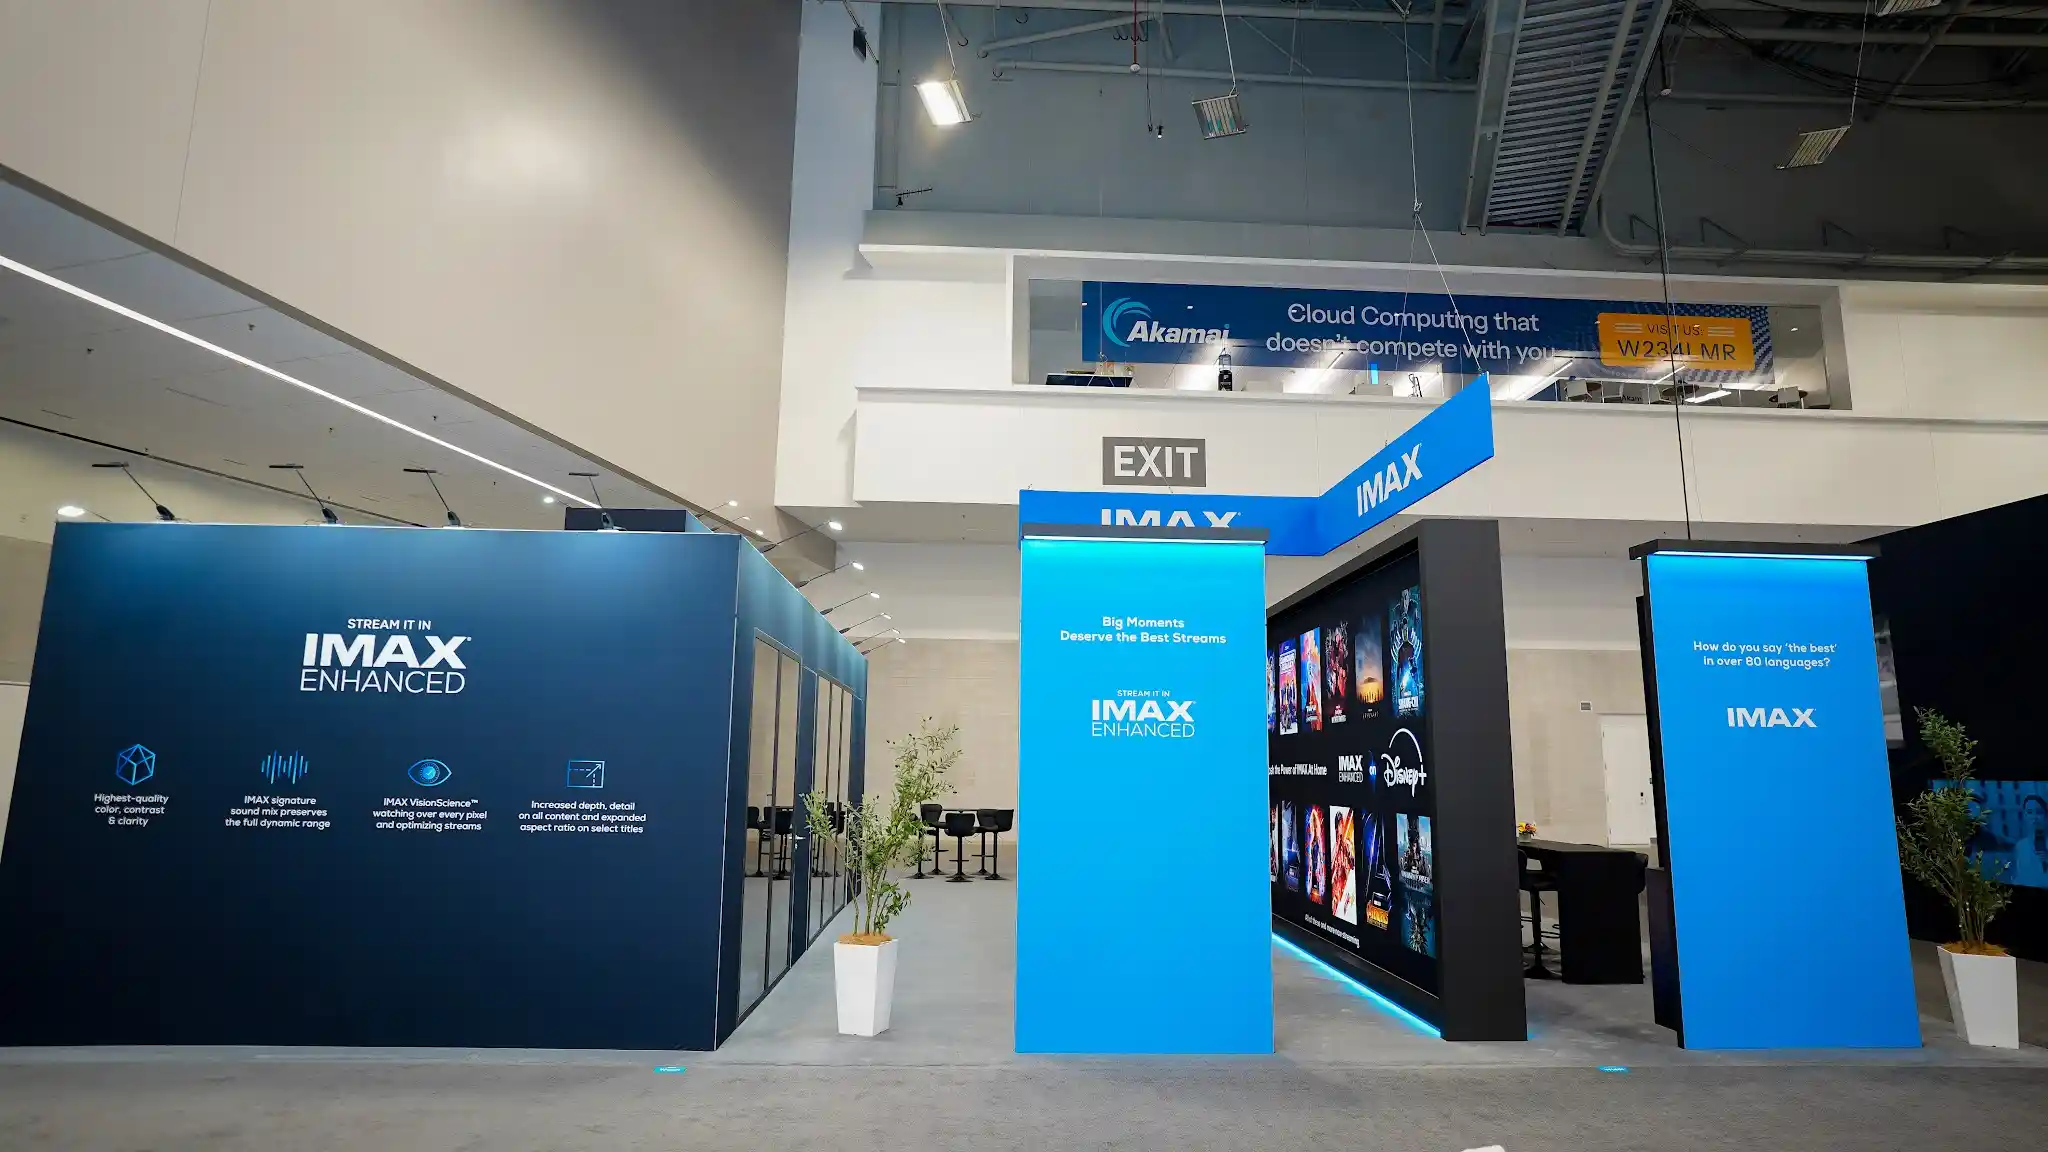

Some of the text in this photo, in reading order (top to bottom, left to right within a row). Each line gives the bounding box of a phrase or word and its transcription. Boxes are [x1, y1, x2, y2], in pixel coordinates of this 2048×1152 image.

[1288, 303, 1540, 335] Cloud Computing that
[1127, 320, 1230, 344] Akamai
[1647, 324, 1680, 337] VISIT
[1356, 339, 1458, 360] compete
[1462, 341, 1511, 360] with
[1517, 344, 1555, 365] you
[1114, 445, 1198, 478] EXIT
[1357, 444, 1423, 517] IMAX
[1101, 508, 1237, 528] IMAX
[347, 618, 431, 631] STREAM IT IN
[1102, 617, 1185, 630] Big Moments
[1060, 630, 1226, 644] Deserve the Best Streams
[303, 633, 472, 669] IMAX
[1693, 641, 1719, 652] How
[1722, 641, 1736, 652] do
[1738, 645, 1760, 655] you
[1762, 645, 1782, 656] say
[1703, 656, 1830, 670] in over 80 languages?
[300, 669, 465, 694] ENHANCED
[1092, 700, 1196, 722] IMAX
[1727, 707, 1817, 728] IMAX
[1092, 722, 1195, 738] ENHANCED
[1280, 763, 1292, 775] Power
[1313, 763, 1327, 775] Home
[1338, 755, 1363, 771] IMAX
[1369, 765, 1377, 775] on
[1381, 753, 1427, 797] Disney+
[1338, 771, 1363, 783] ENHANCED
[94, 794, 169, 805] Highest-quality
[244, 795, 317, 808] IMAX signature
[383, 797, 408, 807] IMAX
[531, 800, 577, 810] Increased
[609, 802, 635, 811] detail
[95, 806, 165, 815] color, contrast
[230, 806, 328, 818] sound mix preserves
[373, 809, 488, 821] watching over every pixel
[518, 810, 647, 823] on all content and expanded
[108, 816, 149, 827] & clarity
[225, 818, 331, 830] the full dynamic range
[376, 820, 482, 832] and optimizing streams
[519, 823, 644, 834] aspect ratio on select titles
